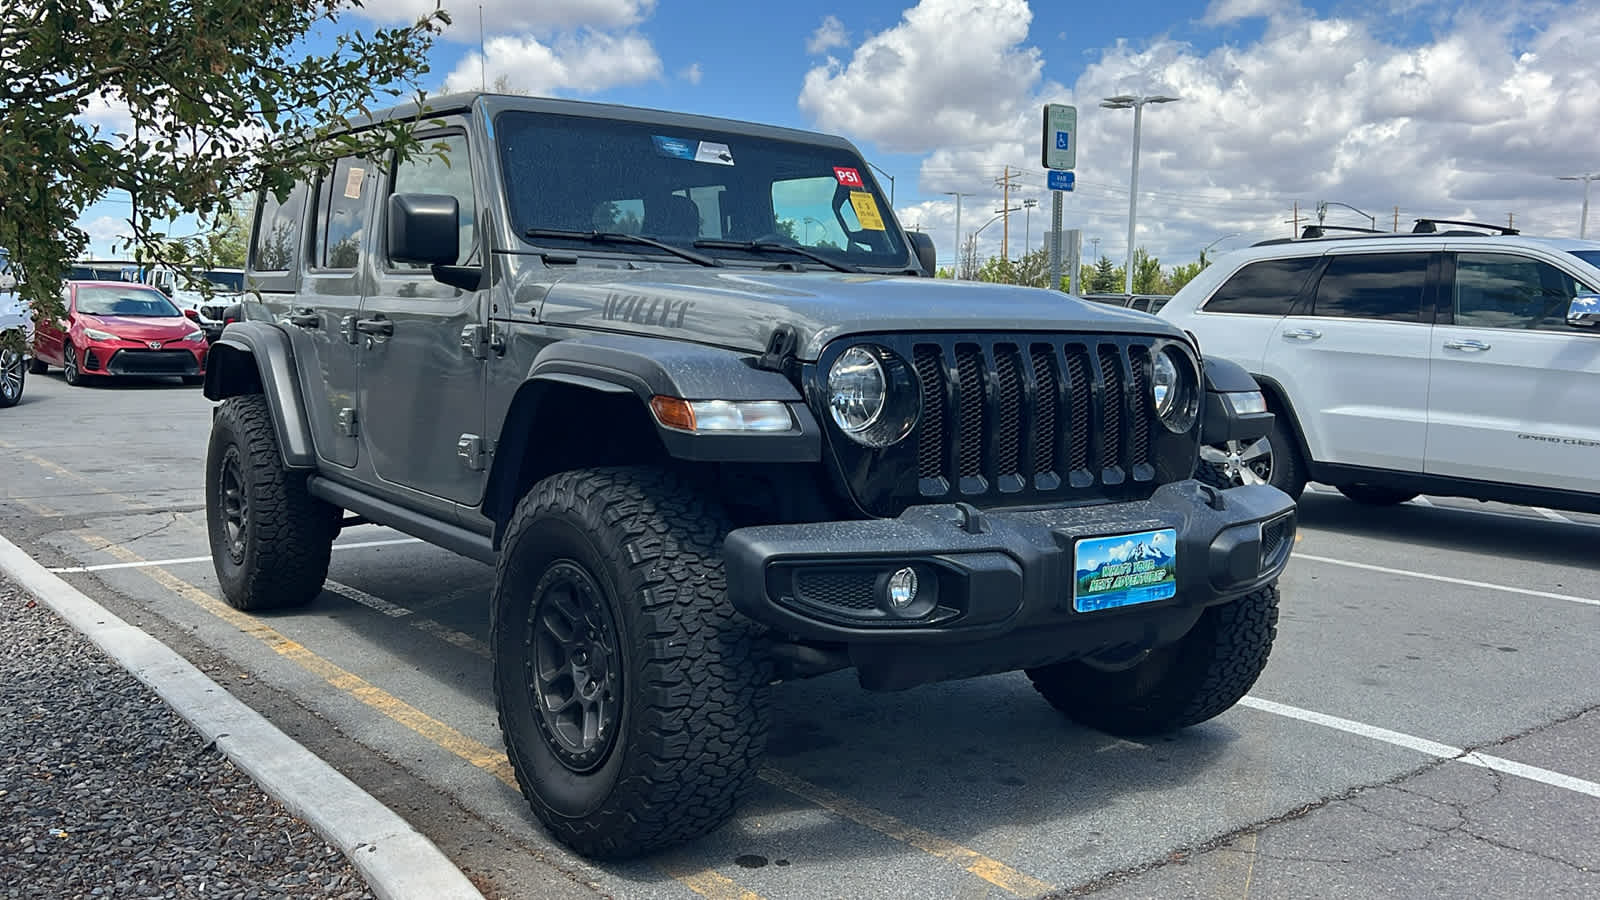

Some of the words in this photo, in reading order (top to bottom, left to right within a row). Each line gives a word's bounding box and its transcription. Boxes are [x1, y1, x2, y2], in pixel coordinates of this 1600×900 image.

[837, 170, 859, 183] PSI
[602, 291, 696, 328] WILLYS
[1518, 433, 1560, 443] GRAND
[1132, 559, 1155, 573] YOUR
[1088, 577, 1114, 593] NEXT
[1111, 568, 1167, 589] ADVENTURE?
